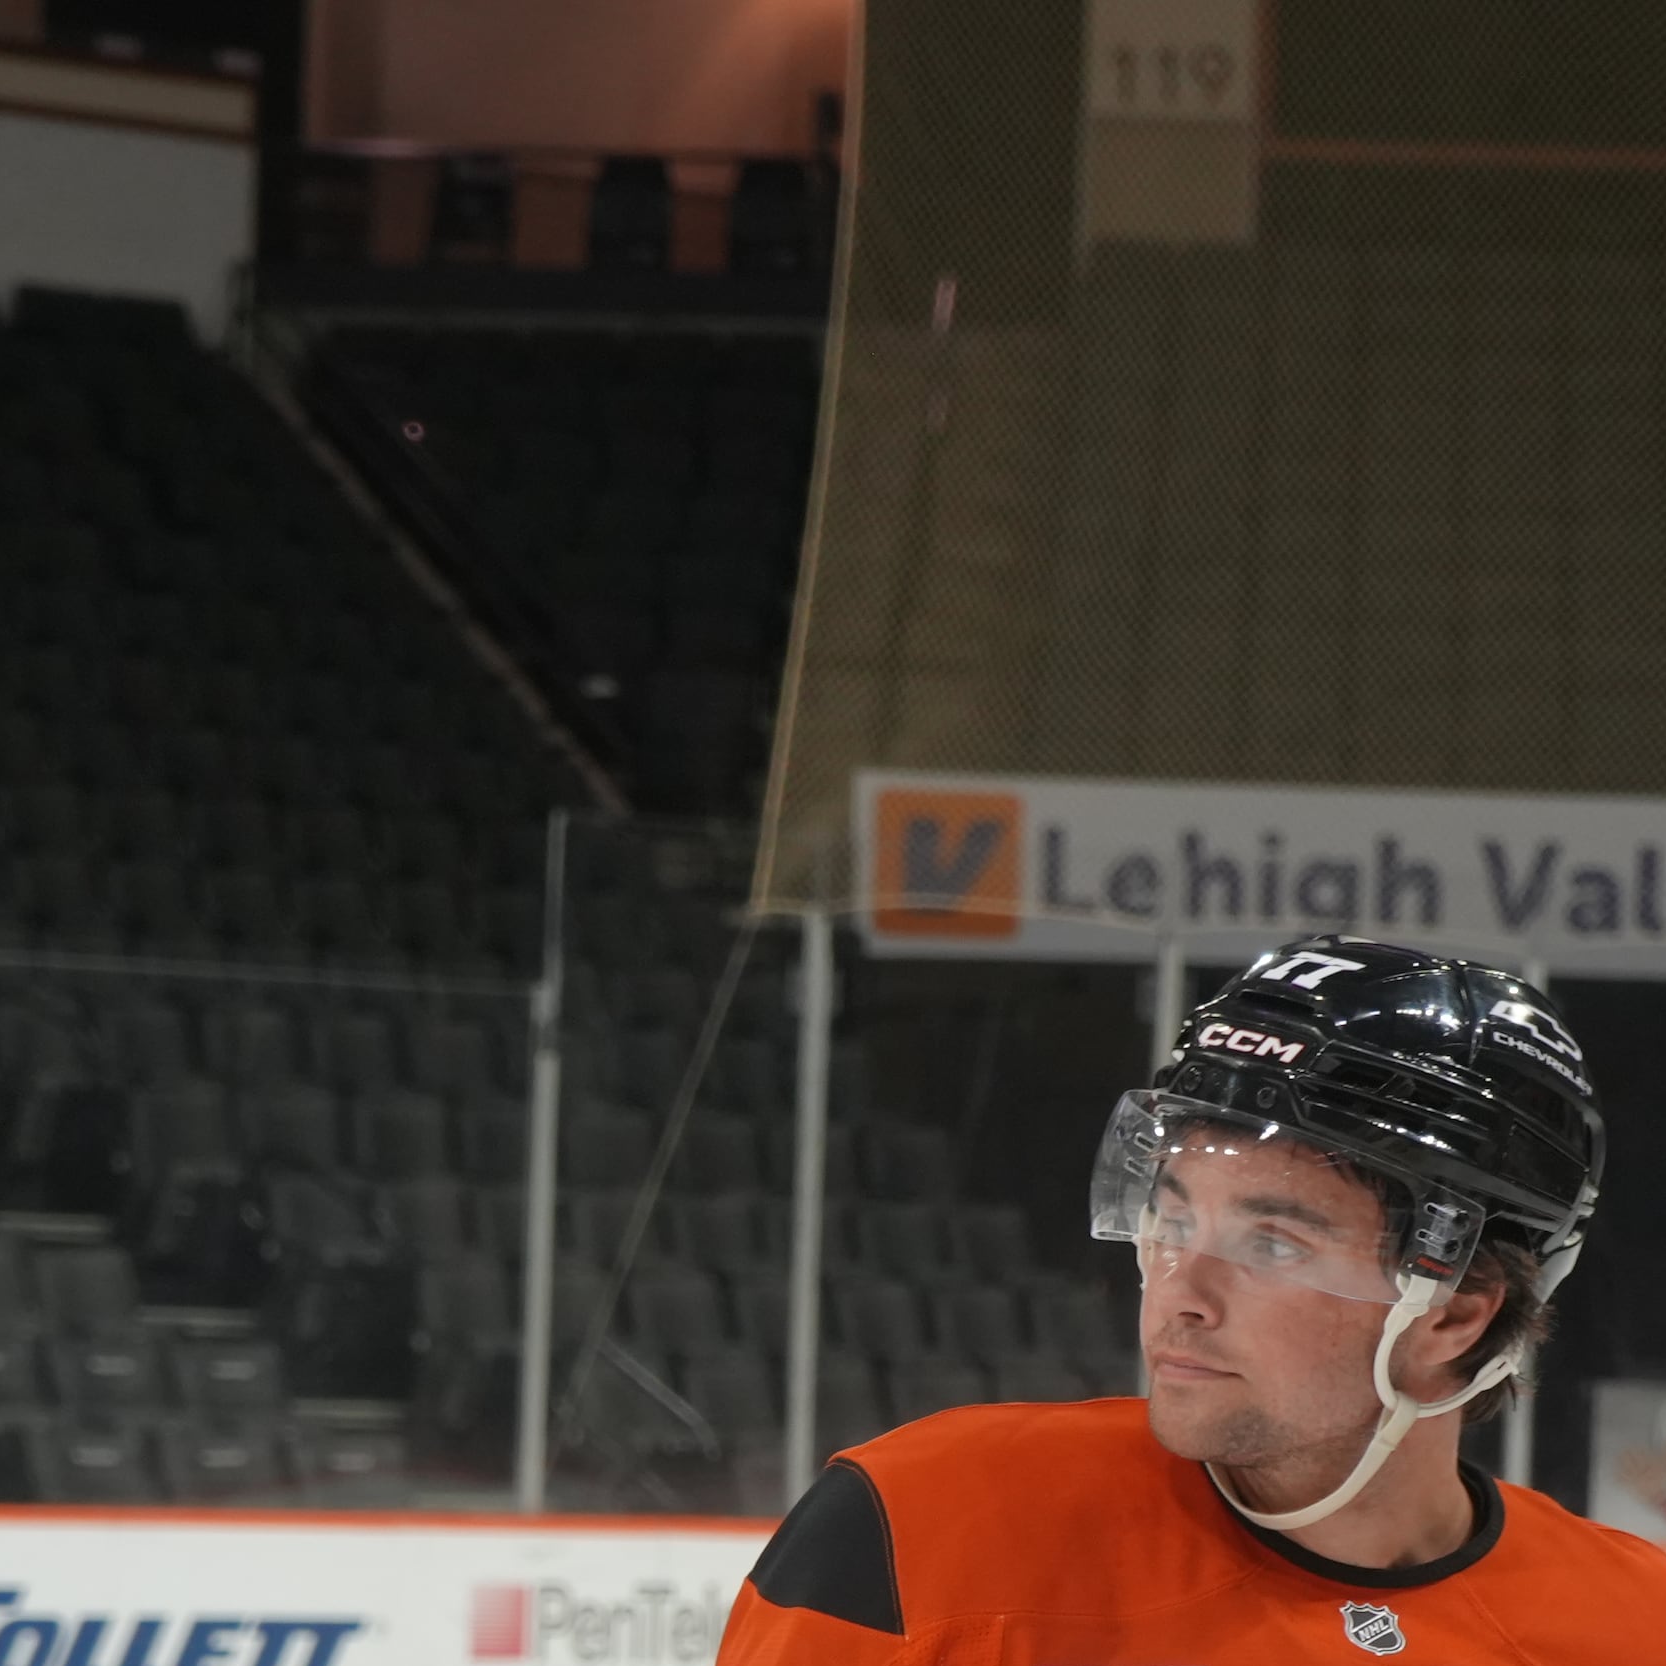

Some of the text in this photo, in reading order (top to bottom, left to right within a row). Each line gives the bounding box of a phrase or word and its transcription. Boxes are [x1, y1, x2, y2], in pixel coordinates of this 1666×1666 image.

[1039, 820, 1441, 938] Lehigh
[1197, 1022, 1306, 1064] CCM
[535, 1581, 725, 1664] PenTel
[1357, 1617, 1391, 1644] NHL
